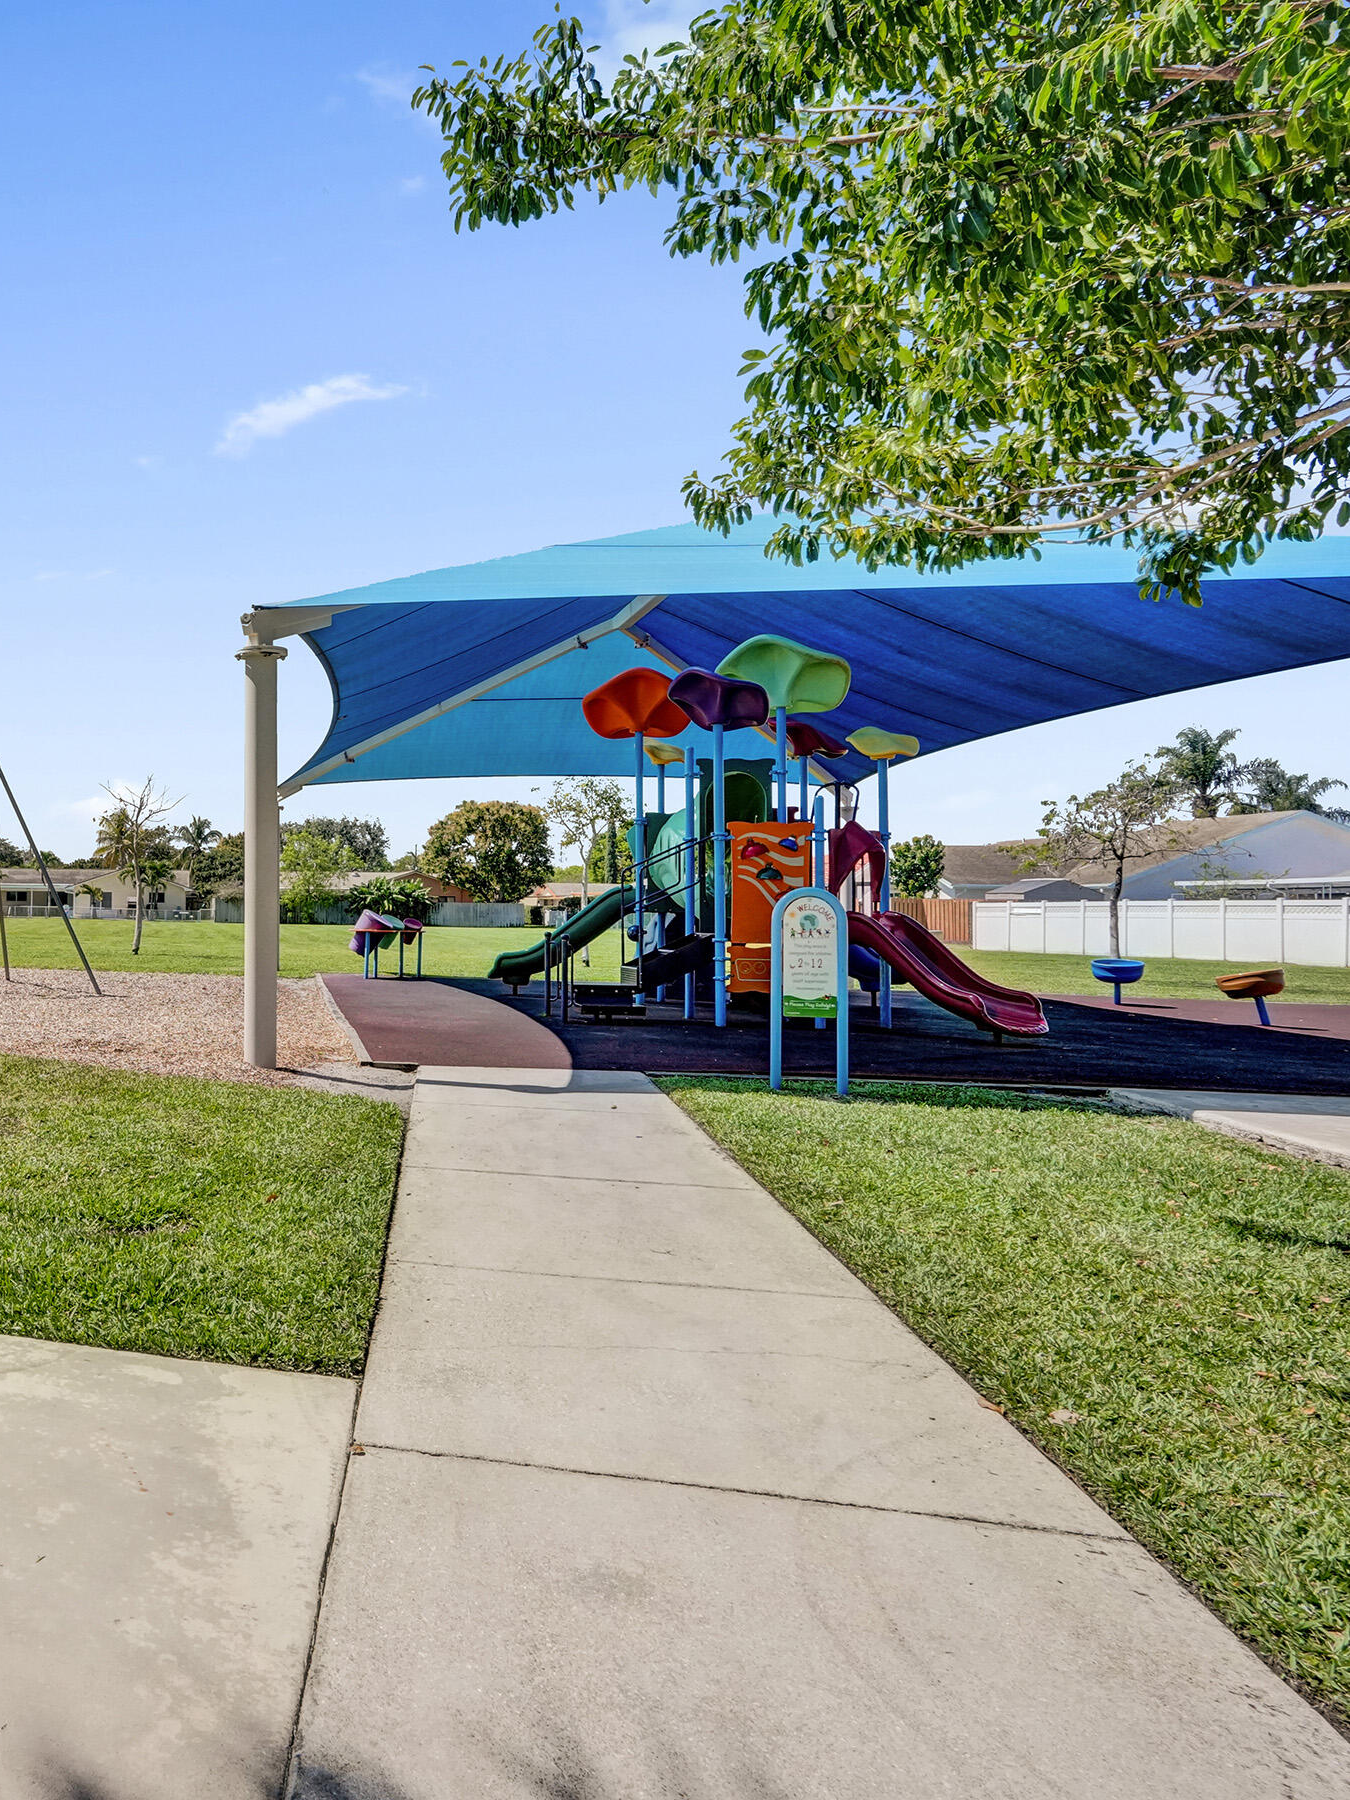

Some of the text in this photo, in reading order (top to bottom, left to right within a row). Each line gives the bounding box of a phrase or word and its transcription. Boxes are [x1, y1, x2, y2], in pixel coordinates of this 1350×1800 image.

[797, 904, 835, 922] WELCOME
[797, 958, 803, 968] 2
[811, 958, 823, 968] 12
